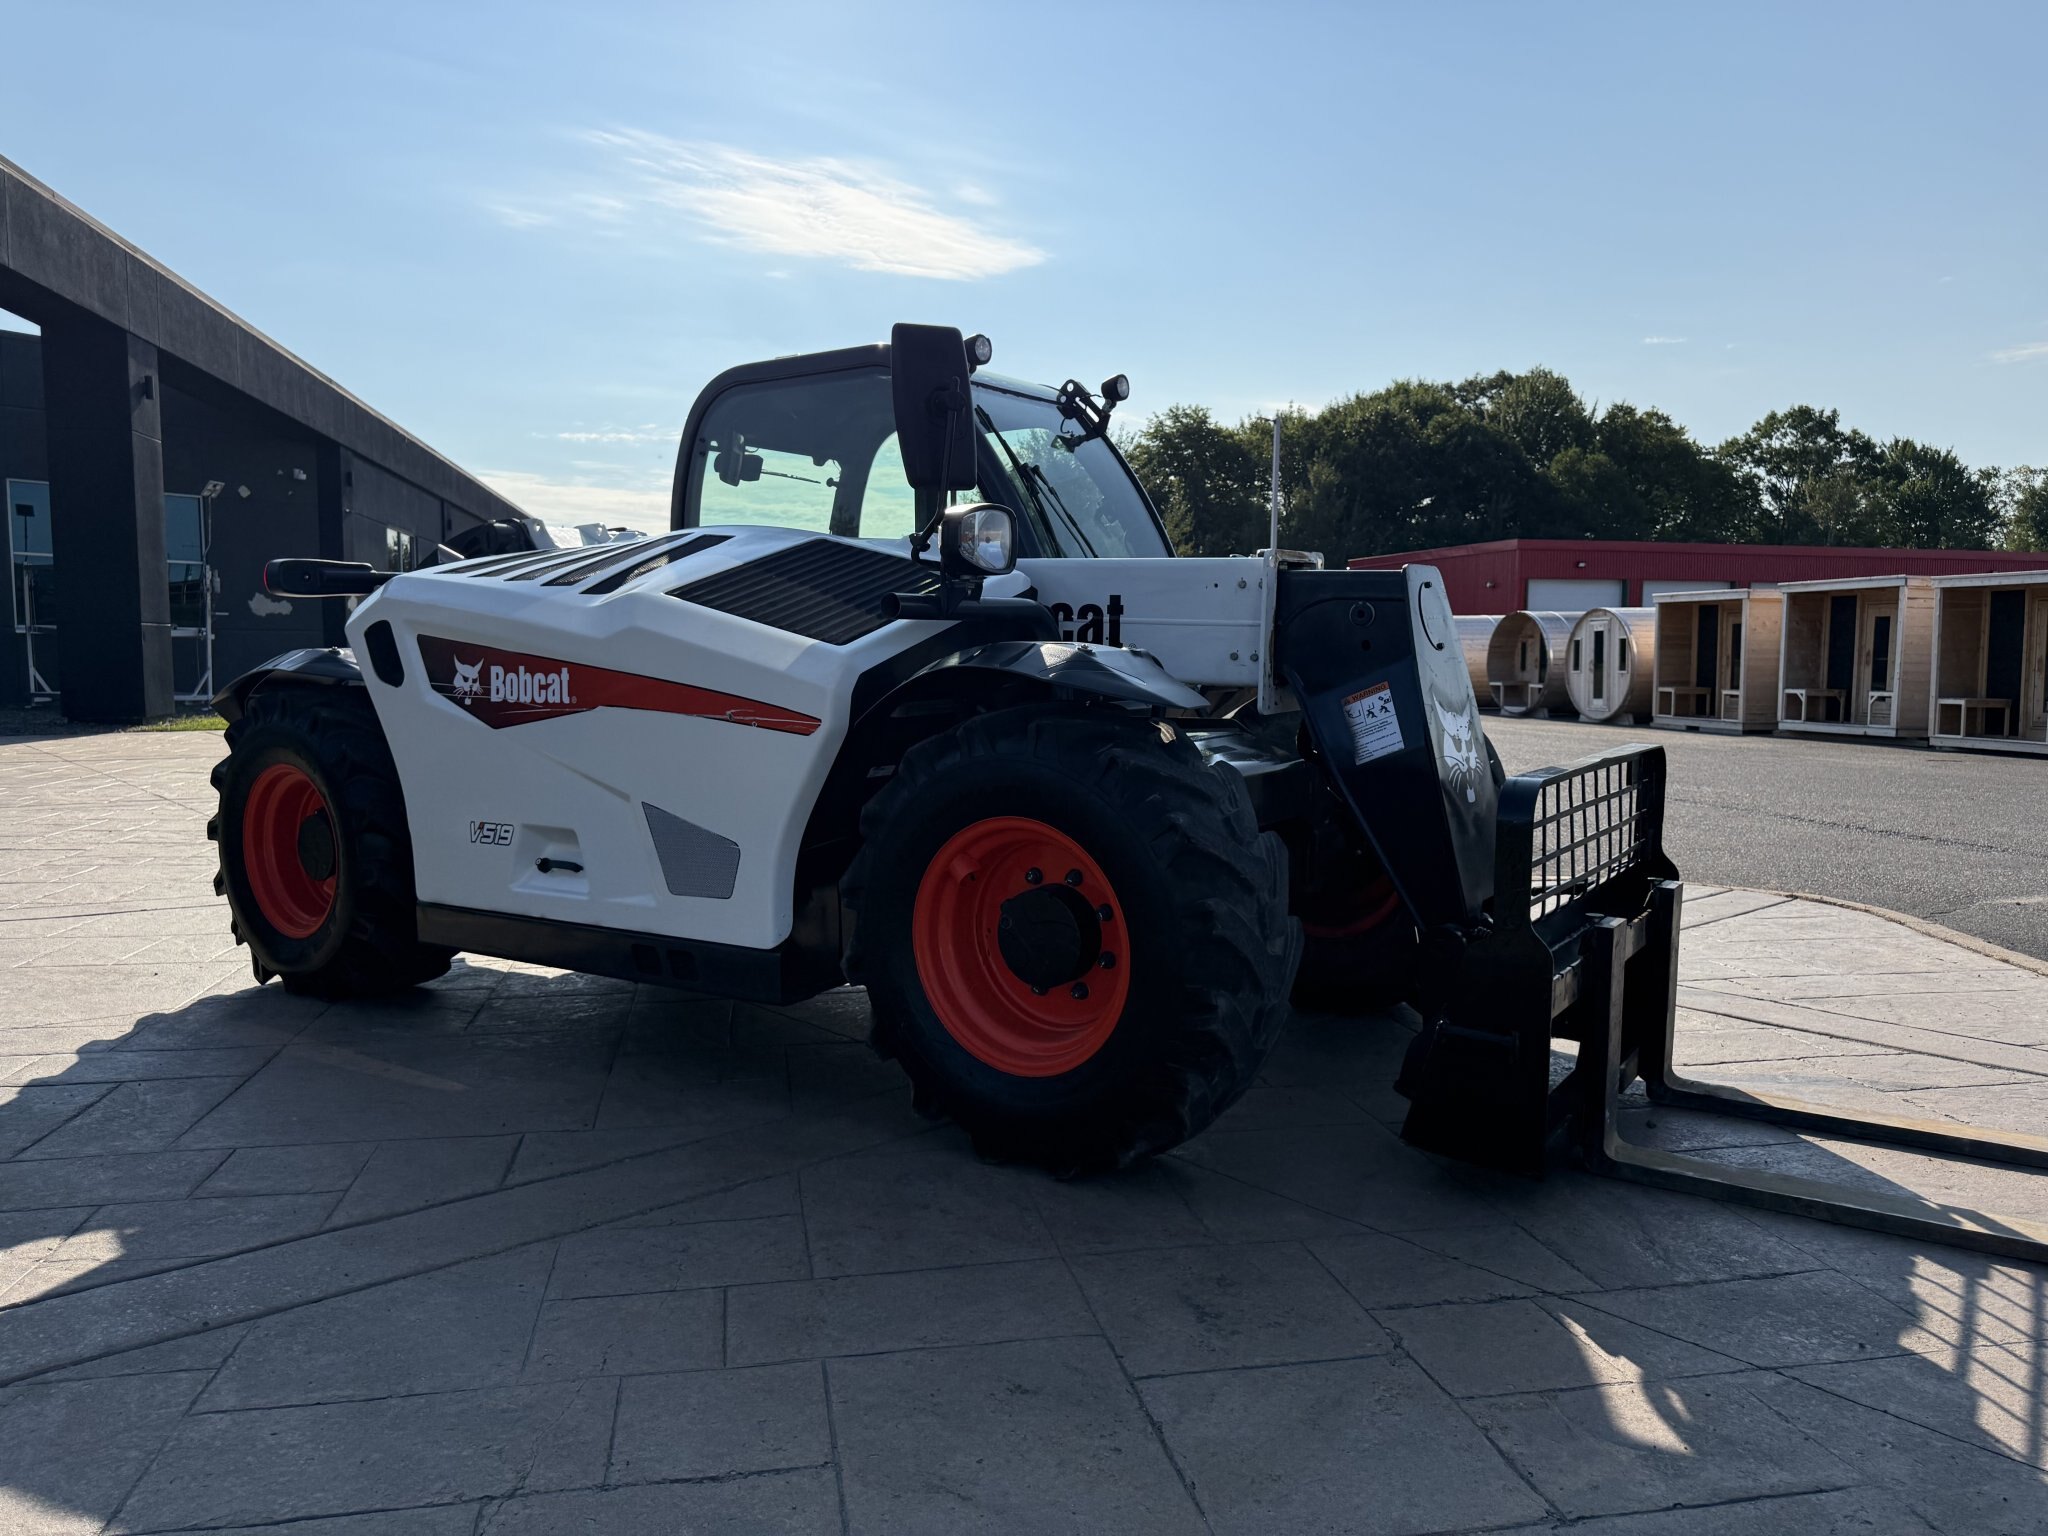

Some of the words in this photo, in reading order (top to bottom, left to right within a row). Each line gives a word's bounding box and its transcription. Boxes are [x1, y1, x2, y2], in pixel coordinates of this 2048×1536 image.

[490, 665, 570, 704] Bobcat
[1351, 684, 1387, 701] WARNING
[470, 820, 514, 846] V519
